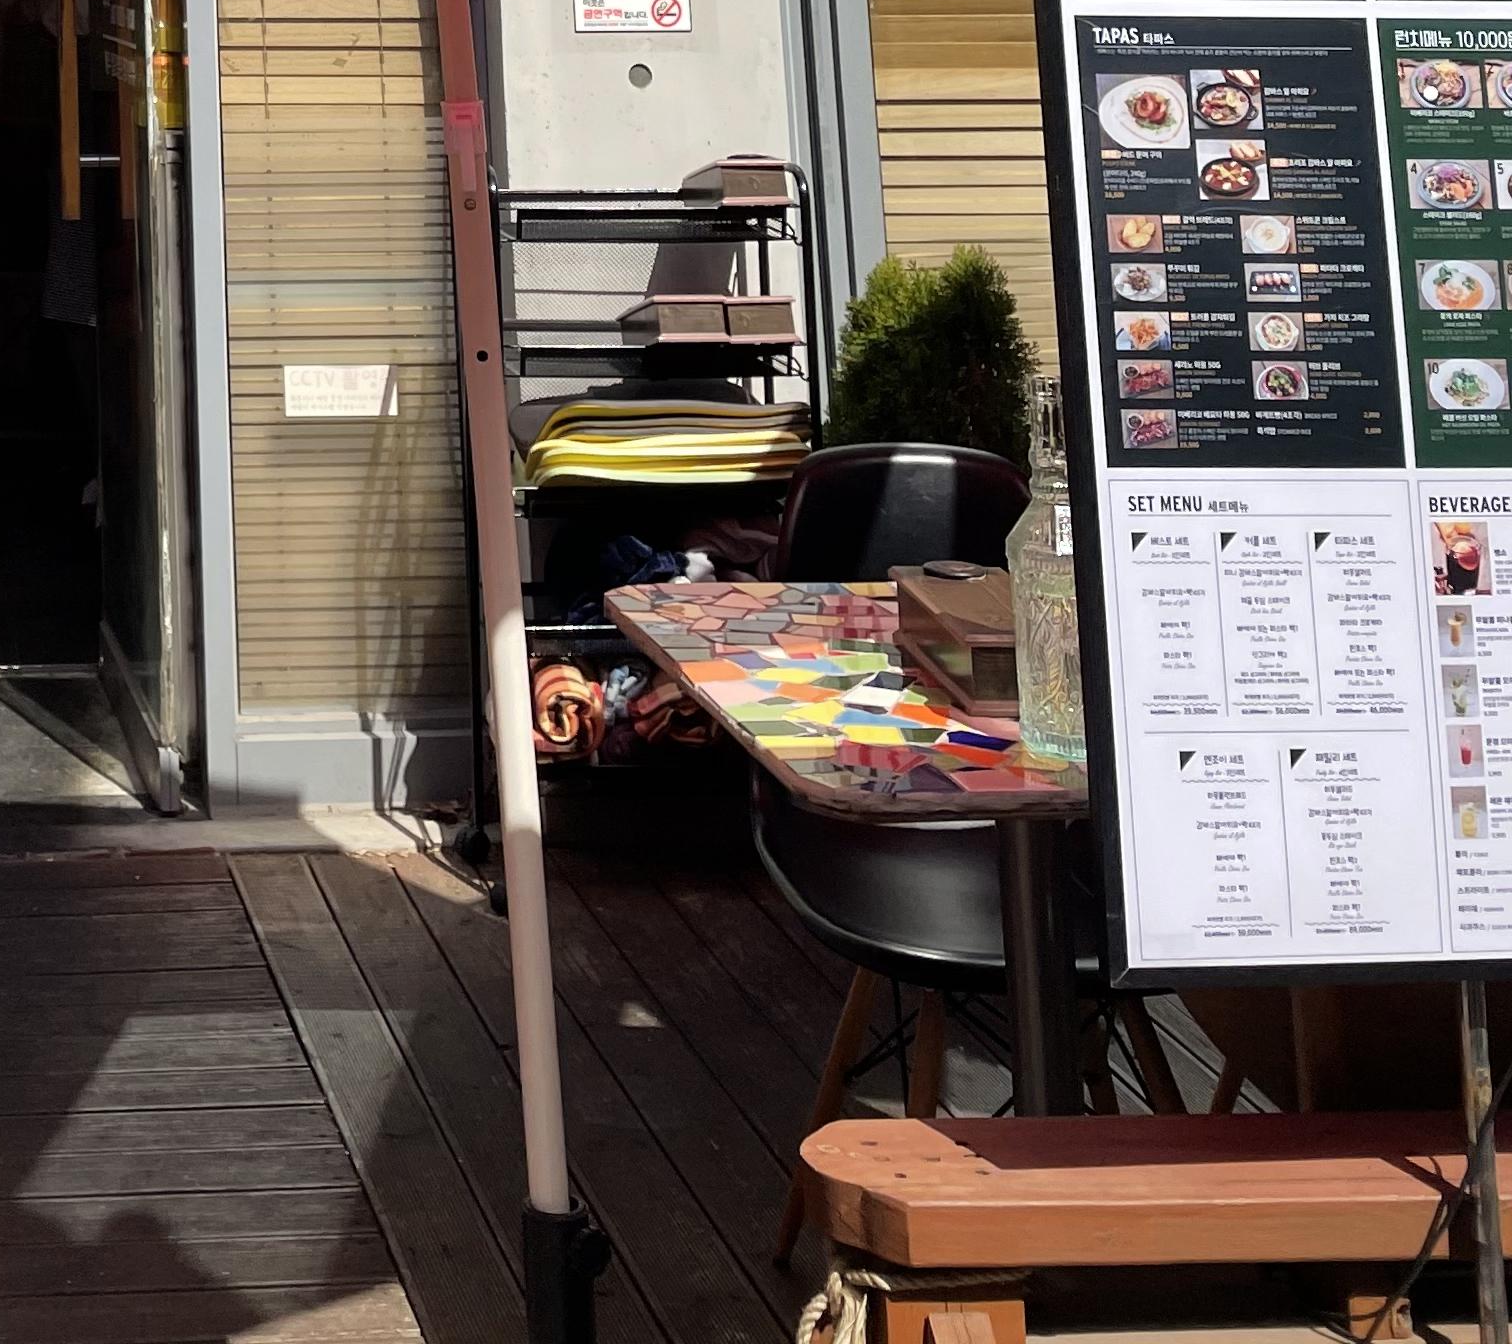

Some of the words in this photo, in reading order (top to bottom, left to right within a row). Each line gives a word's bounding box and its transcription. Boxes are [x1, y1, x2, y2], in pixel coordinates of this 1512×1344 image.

[584, 9, 623, 20] 금연구역
[1092, 27, 1140, 46] TAPAS
[1143, 32, 1175, 46] 타파스
[1394, 29, 1453, 49] 런치메뉴
[289, 369, 336, 388] CCTV
[1128, 495, 1155, 512] SET
[1160, 495, 1202, 512] MENU
[1428, 495, 1512, 514] BEVERAGE
